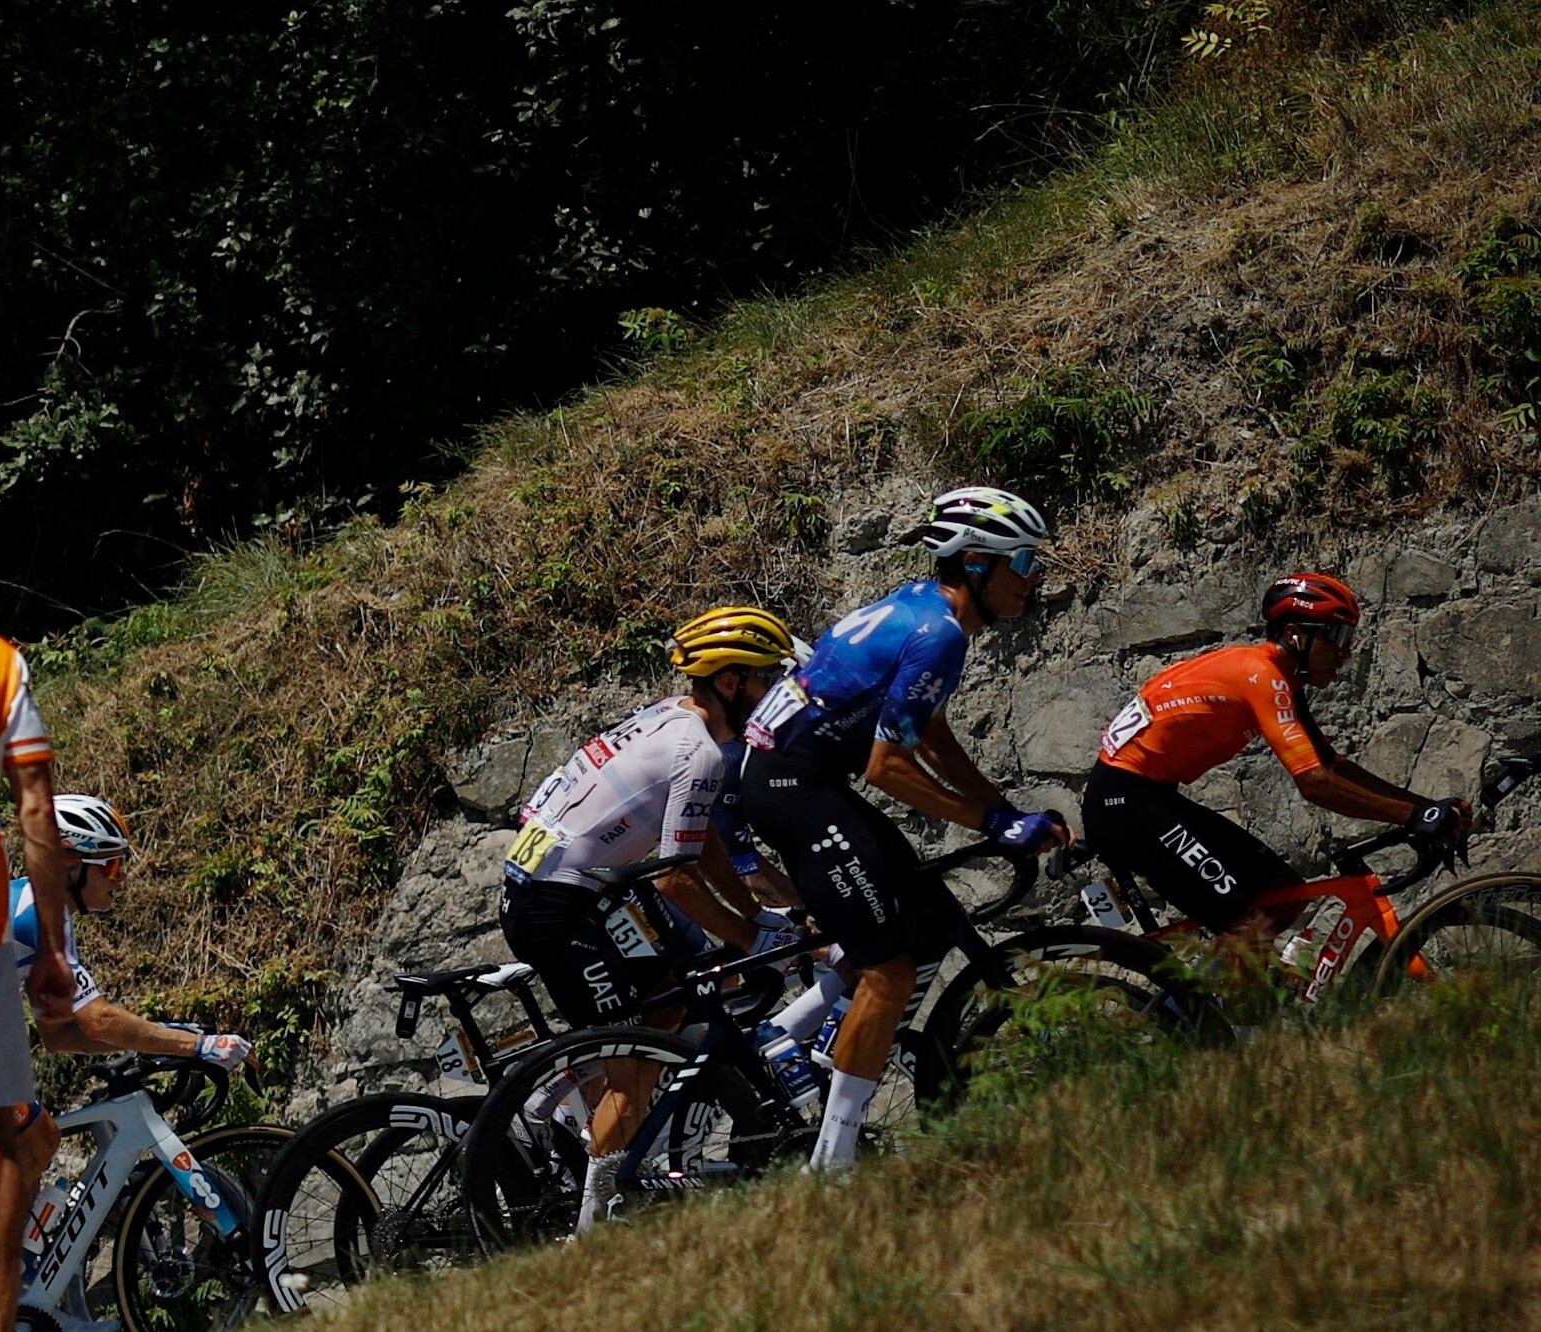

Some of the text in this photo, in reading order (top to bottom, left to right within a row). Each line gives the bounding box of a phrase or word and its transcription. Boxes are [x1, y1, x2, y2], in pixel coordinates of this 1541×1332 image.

[907, 671, 933, 700] vivo
[1271, 678, 1304, 743] INEOS
[690, 779, 720, 793] FAB
[769, 778, 798, 788] GOBIK
[510, 827, 546, 866] 18
[599, 817, 631, 844] FABY
[1159, 823, 1237, 895] INEOS
[827, 865, 853, 900] Tech
[845, 856, 887, 926] Telefónica
[1088, 892, 1113, 918] 32
[607, 918, 643, 956] 151
[583, 961, 623, 1013] UAE
[435, 1047, 463, 1072] 18
[639, 1175, 706, 1191] CANYON
[40, 1160, 109, 1291] SCOTT
